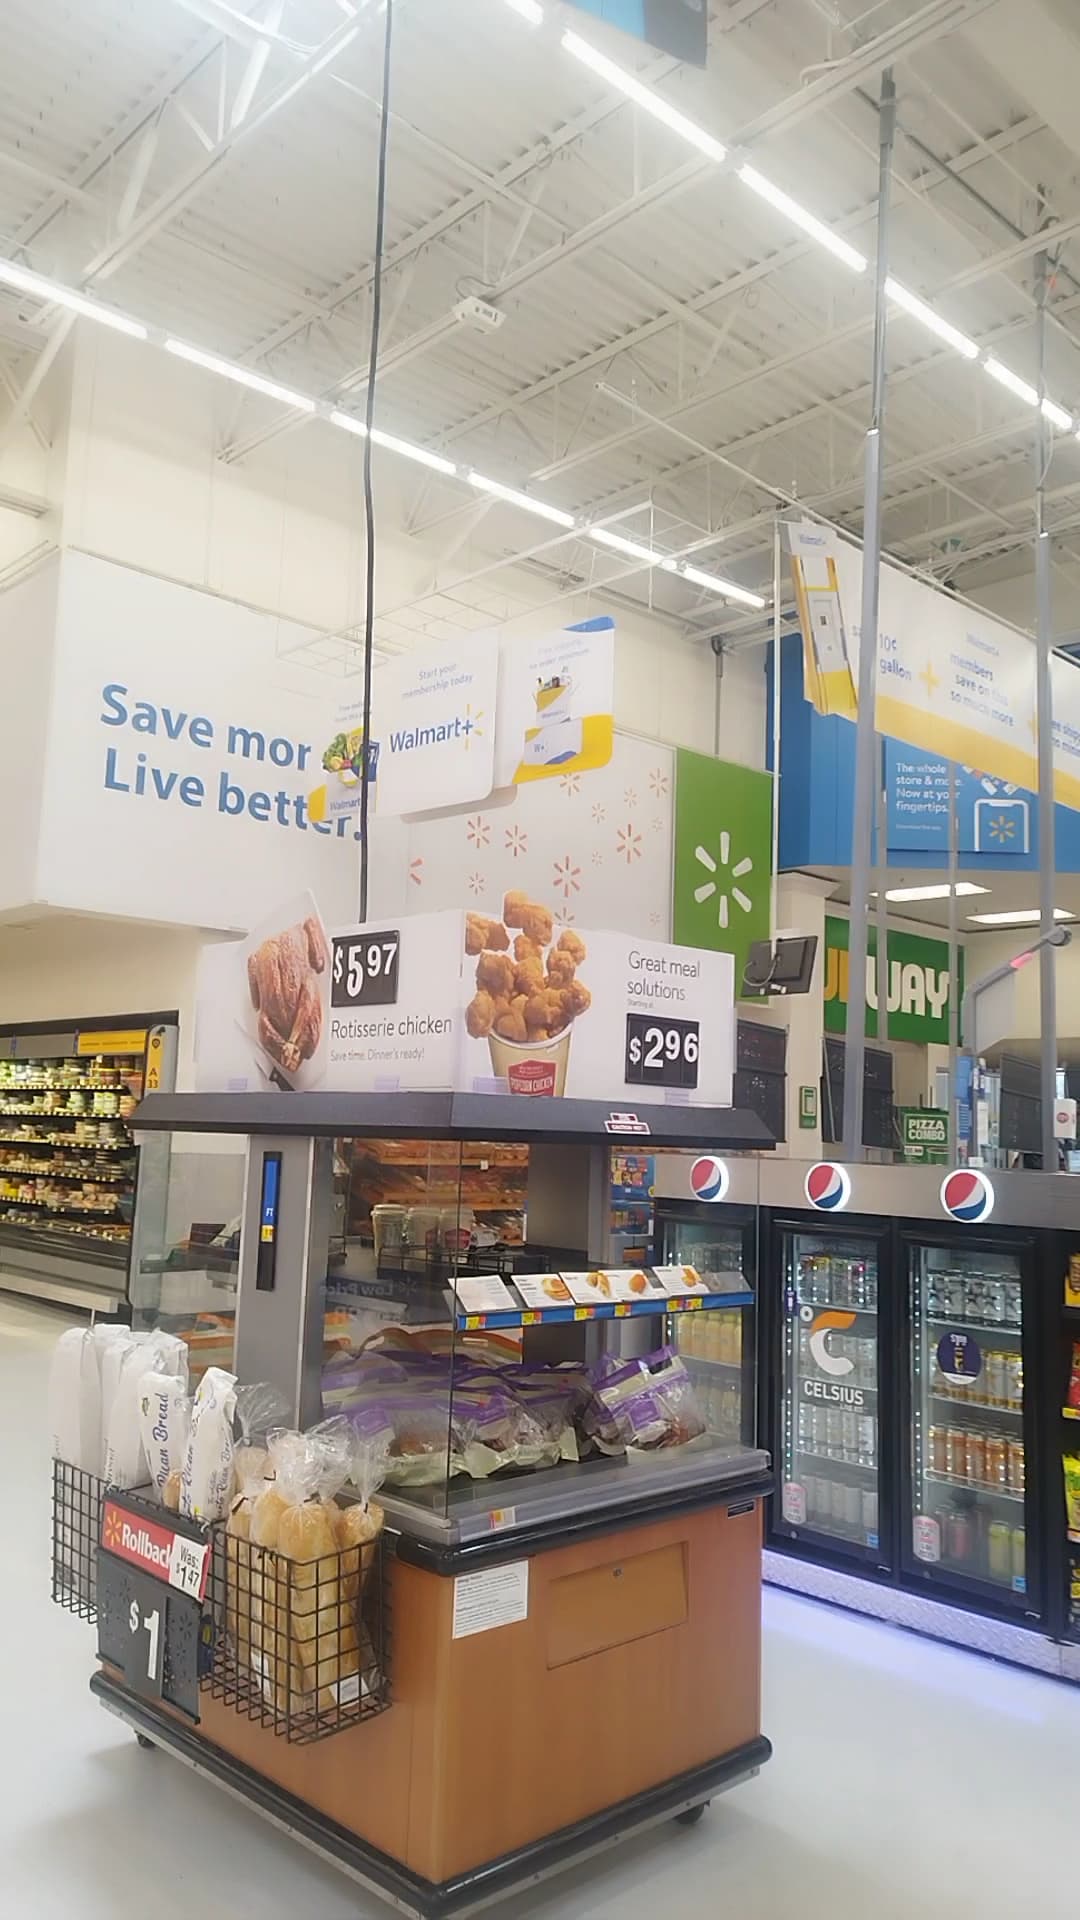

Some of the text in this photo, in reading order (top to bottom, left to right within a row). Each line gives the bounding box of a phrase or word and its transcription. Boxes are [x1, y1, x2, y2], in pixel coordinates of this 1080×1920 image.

[418, 667, 437, 681] Start
[879, 658, 912, 681] gallon
[450, 674, 473, 687] today
[100, 683, 312, 771] Save mor
[104, 746, 204, 807] Live
[896, 762, 947, 774] The whole
[896, 775, 966, 786] store & moe.
[896, 788, 960, 800] Now at yor
[628, 951, 700, 978] Great meal
[627, 977, 686, 1001] solutions
[331, 1015, 452, 1039] Rotisserie chicken
[399, 1047, 425, 1061] ready!
[148, 1067, 158, 1077] A
[908, 1119, 945, 1130] PIZZA
[908, 1129, 946, 1141] COMBO
[803, 1379, 864, 1406] CELSIUS
[152, 1392, 168, 1442] Bread
[180, 1544, 199, 1568] Was:
